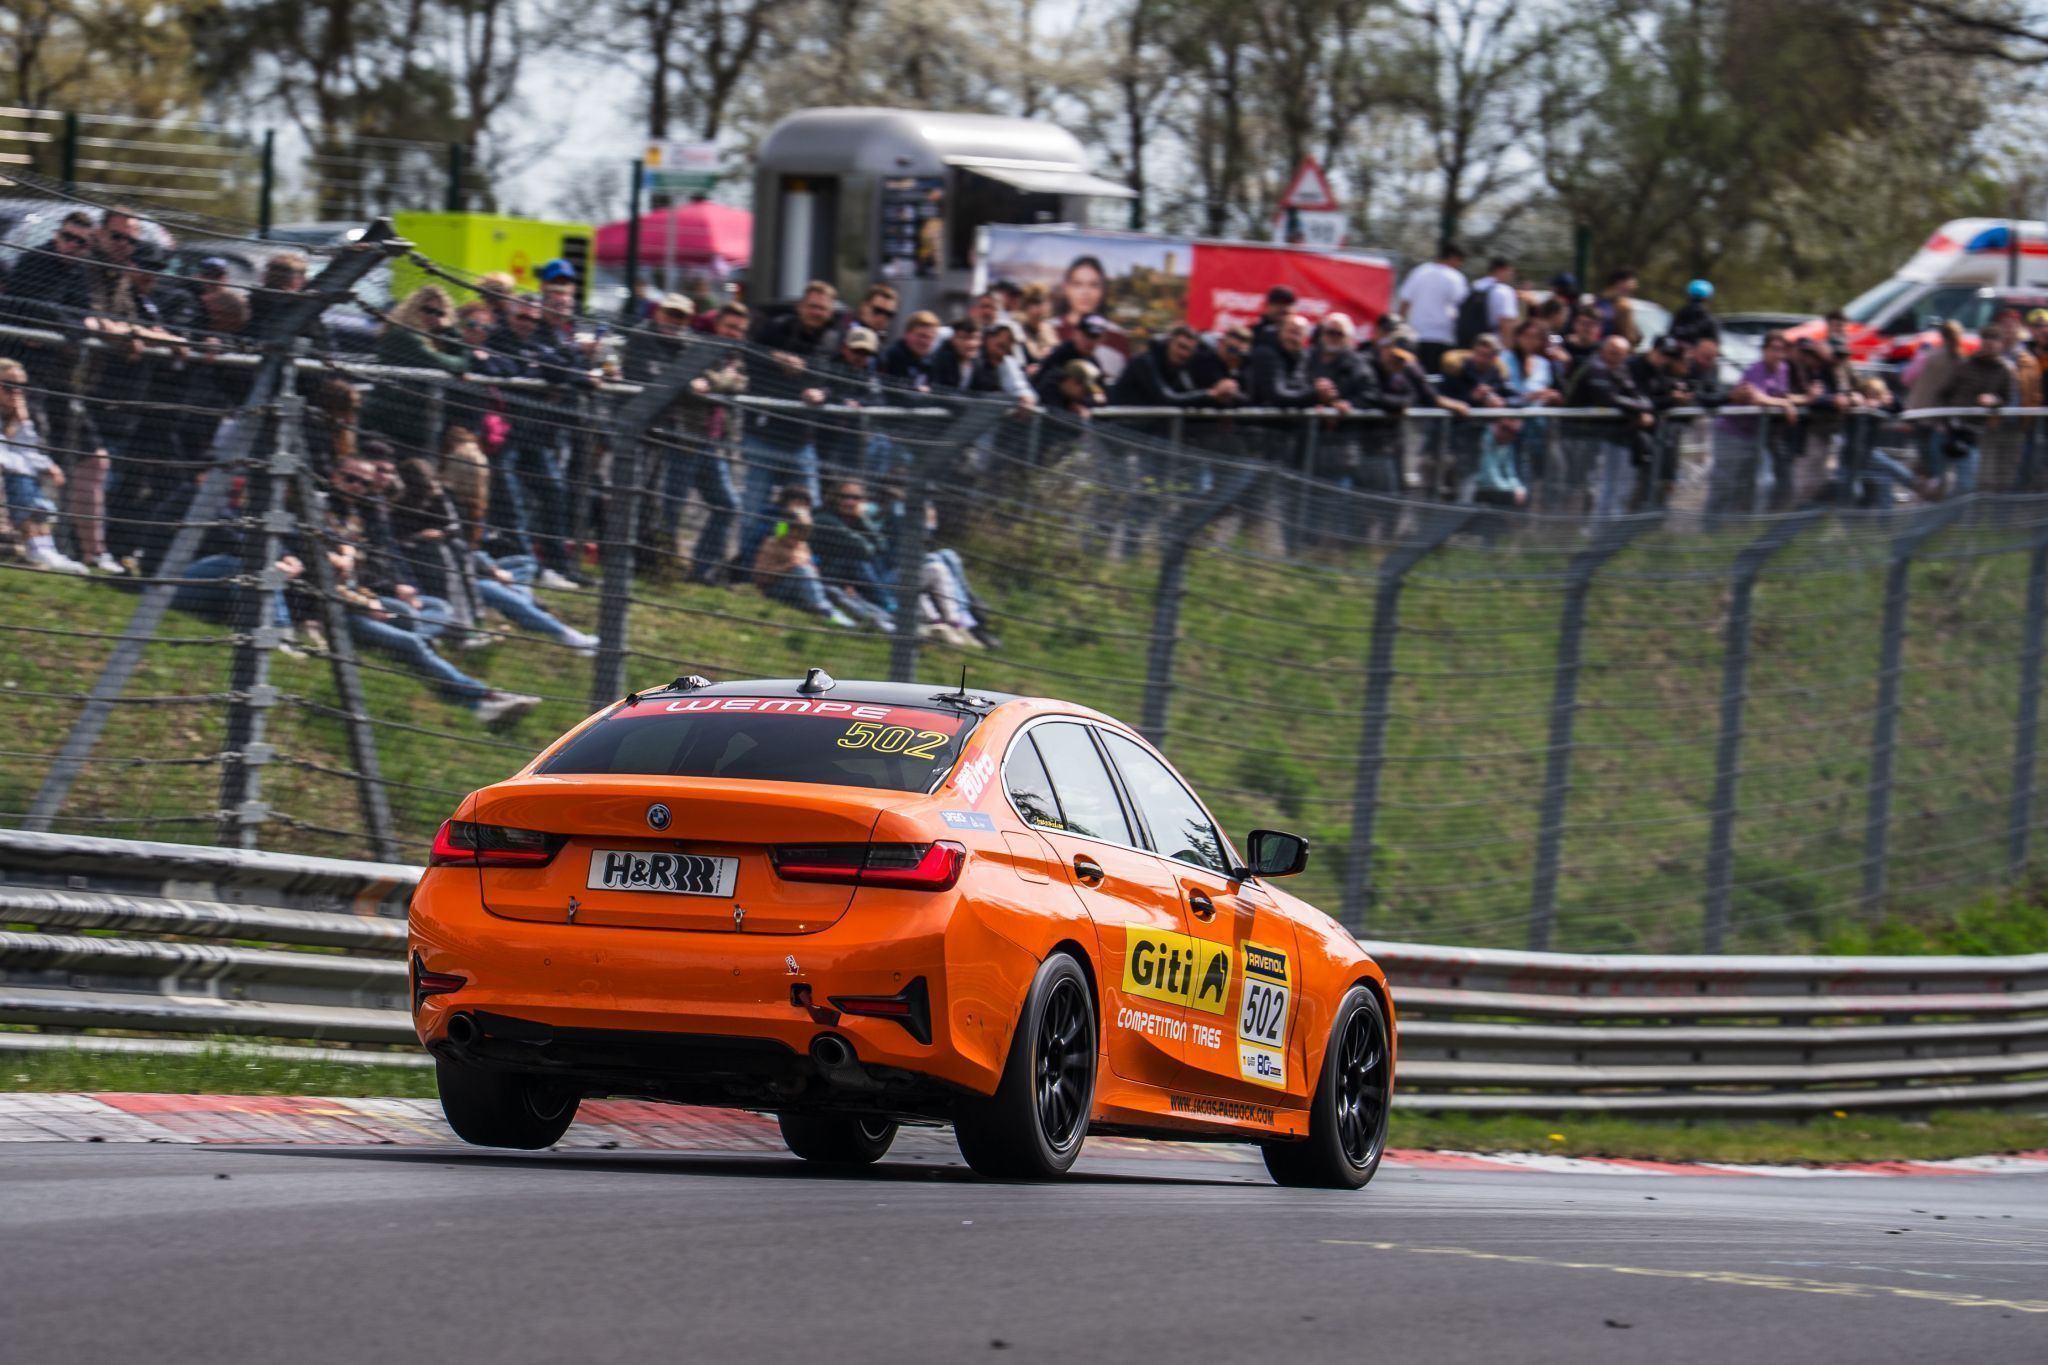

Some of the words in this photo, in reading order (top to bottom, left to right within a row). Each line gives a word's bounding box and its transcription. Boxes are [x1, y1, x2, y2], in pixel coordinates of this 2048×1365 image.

[837, 721, 950, 760] 502
[1131, 940, 1193, 996] Giti
[1248, 952, 1284, 974] RAVENOL
[1117, 1007, 1187, 1042] COMPETITION
[1192, 1023, 1222, 1049] TIRES
[1243, 984, 1285, 1040] 502
[1170, 1095, 1275, 1126] WWW.JACOS-PADDOCK.COM
